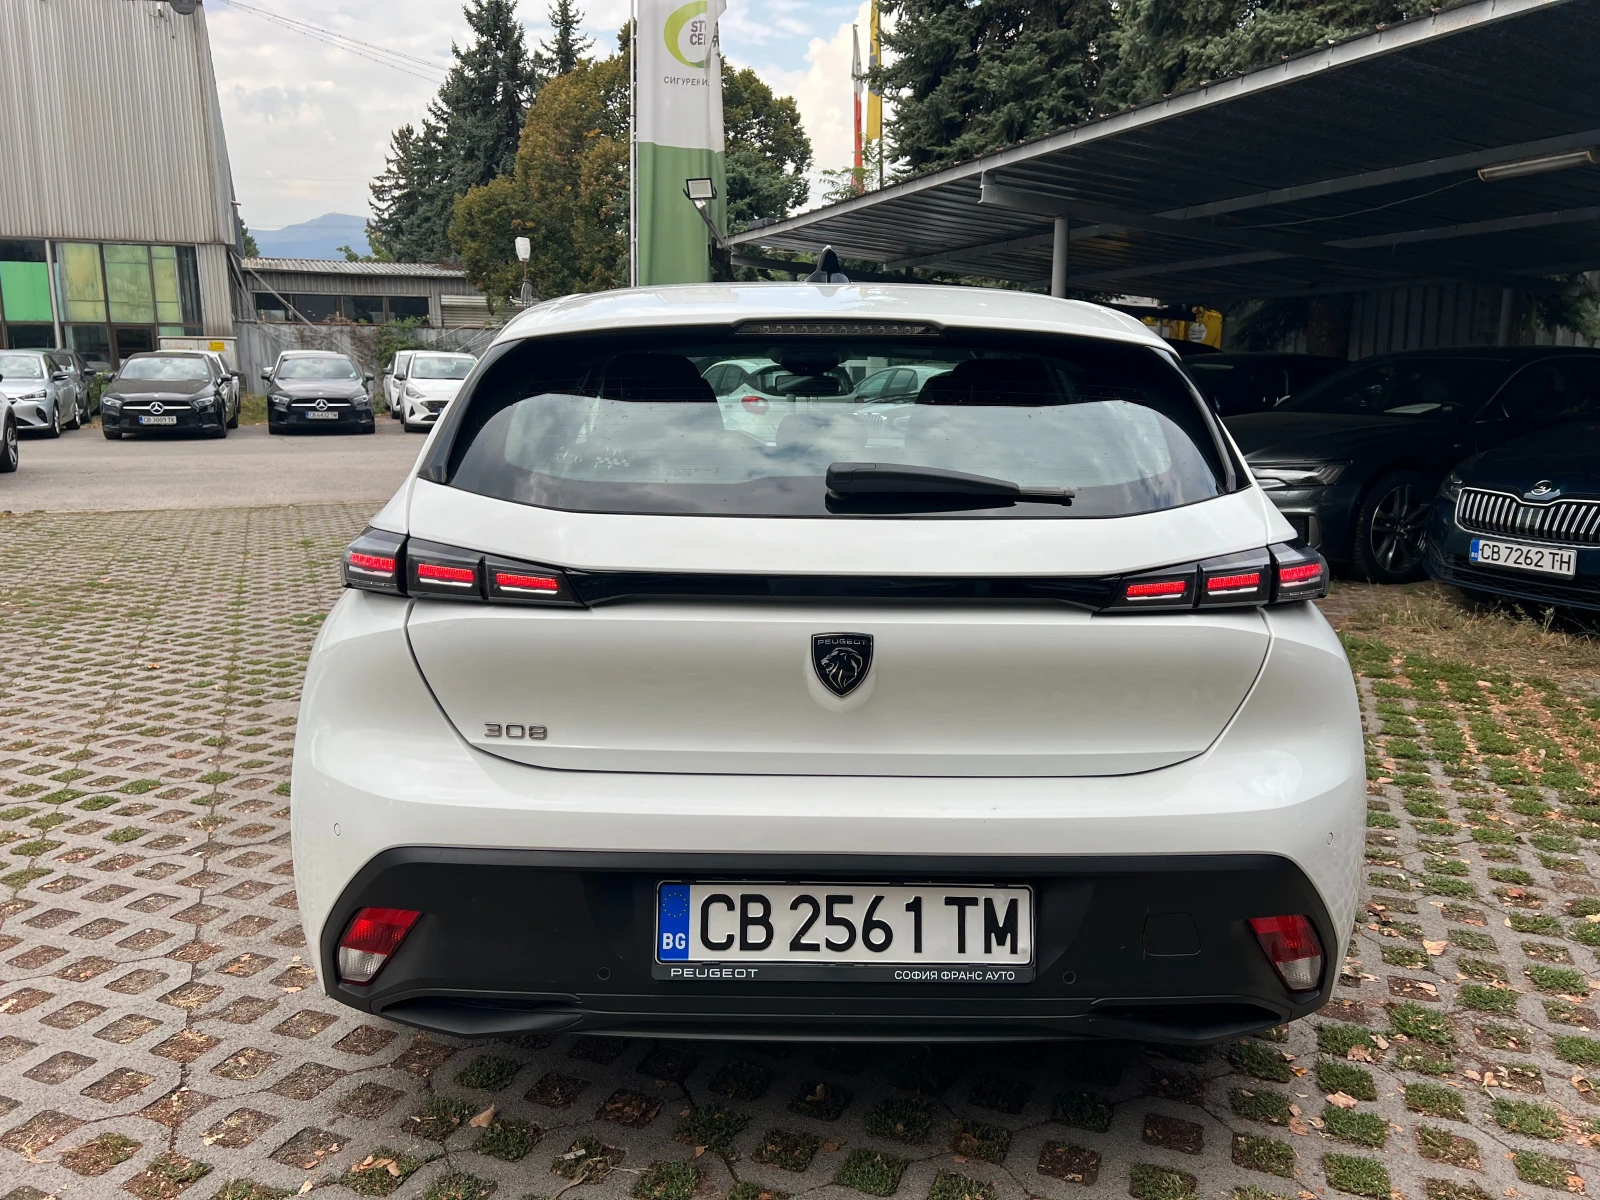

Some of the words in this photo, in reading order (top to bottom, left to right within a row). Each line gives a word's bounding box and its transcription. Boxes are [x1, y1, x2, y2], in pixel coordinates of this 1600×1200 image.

[663, 76, 700, 86] СИГУРЕН
[1481, 543, 1500, 561] CB
[1504, 546, 1544, 568] 7262
[1549, 552, 1571, 572] TH
[817, 638, 867, 646] PEUGEOT
[484, 722, 548, 740] 308
[700, 893, 774, 951] CB
[789, 894, 923, 954] 2561
[944, 896, 1019, 955] TM
[662, 932, 686, 950] BG
[670, 968, 758, 978] PEUGEOT
[894, 970, 938, 980] СОФИЯ
[940, 970, 983, 981] ФРАНС
[985, 971, 1015, 981] АУТО
